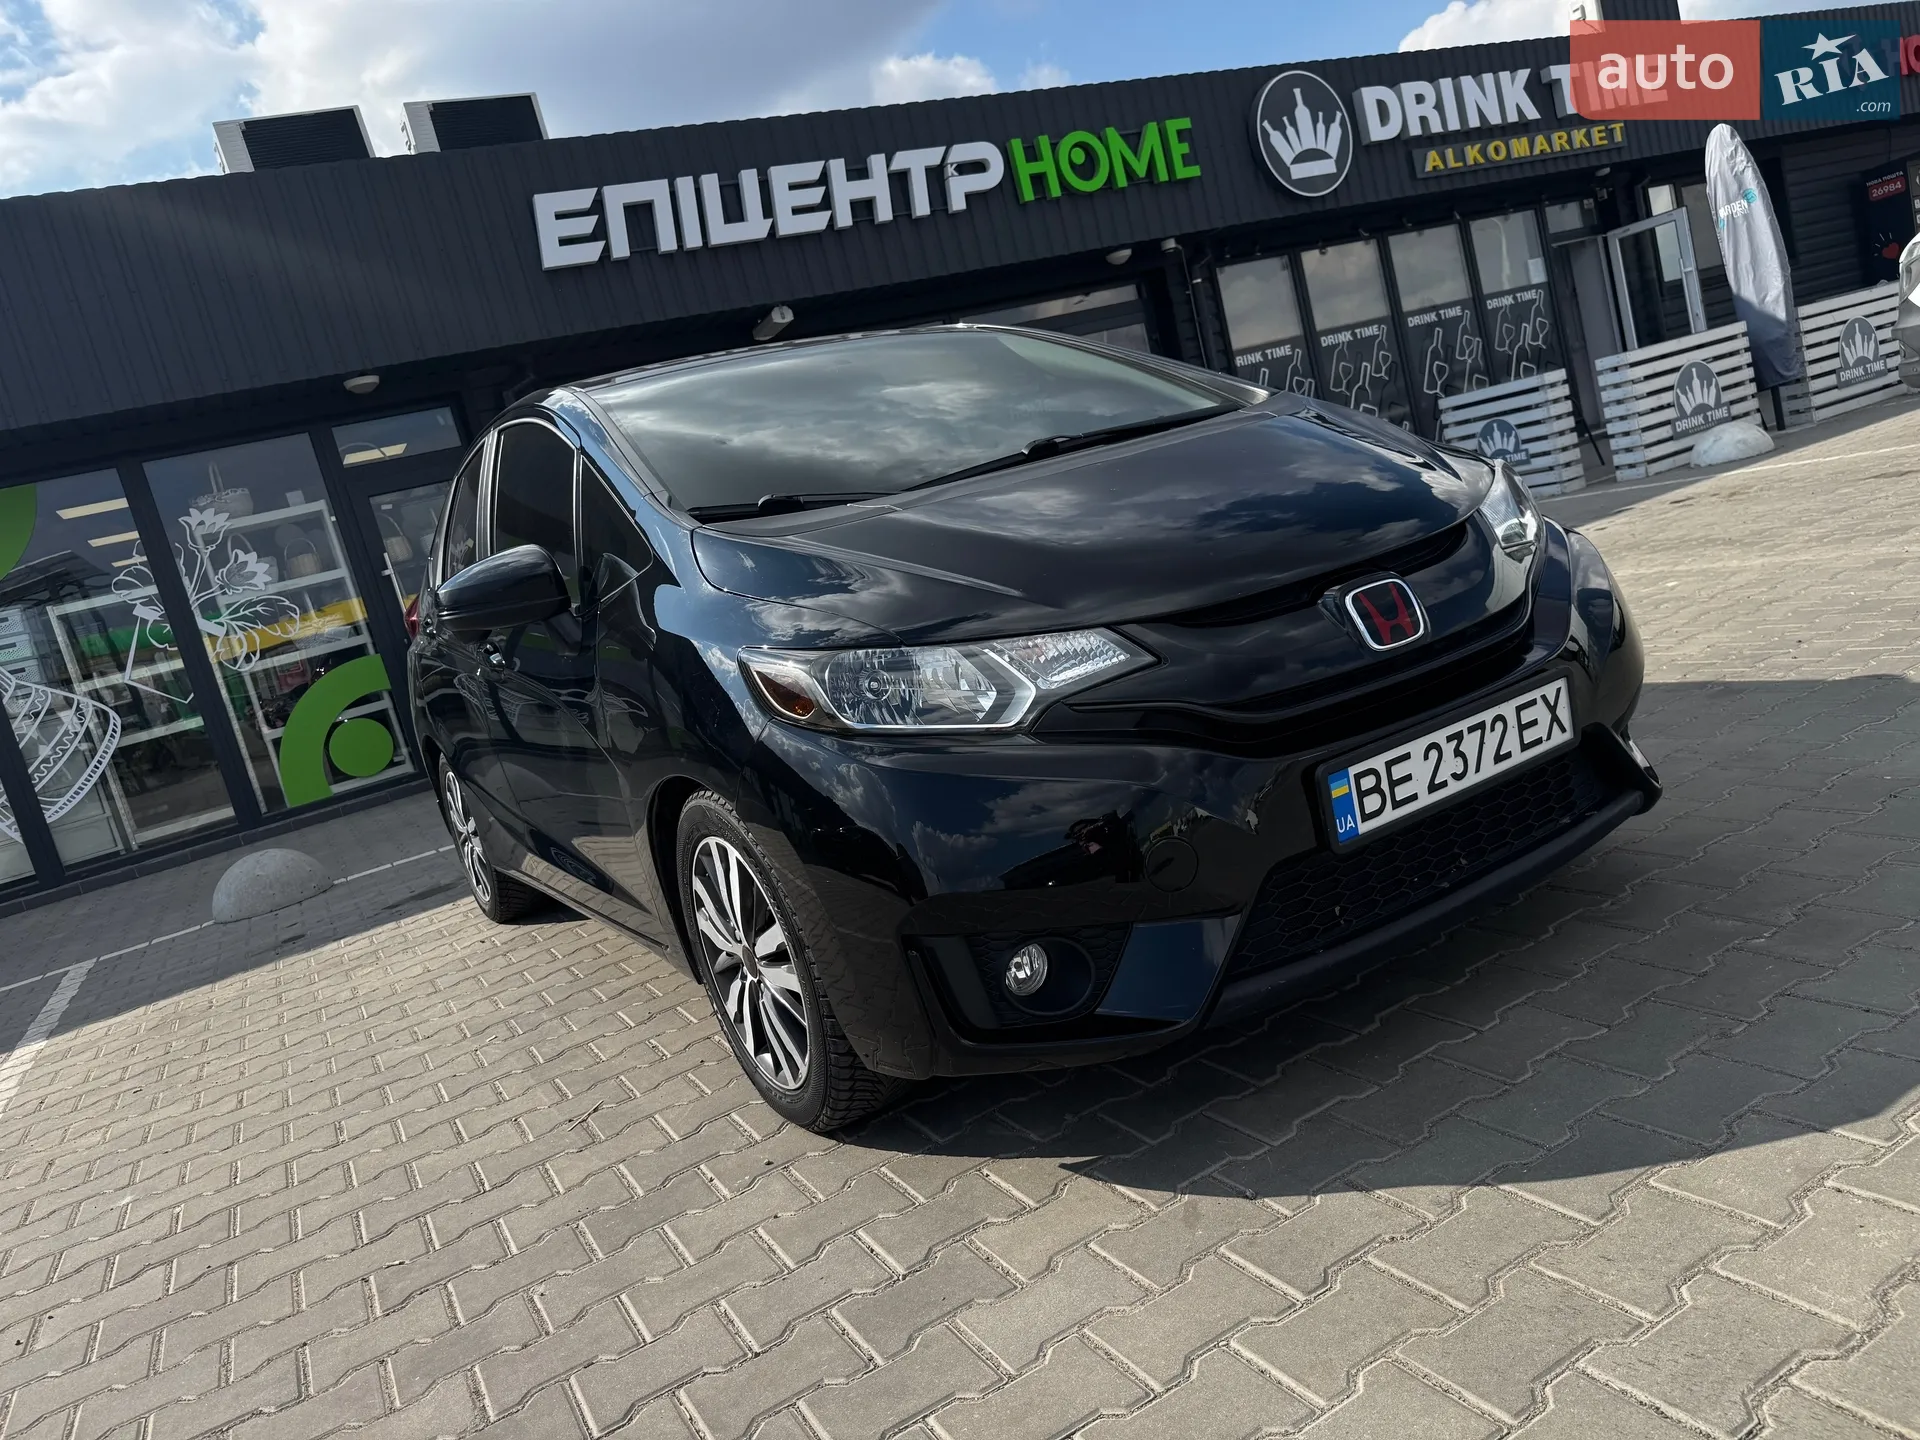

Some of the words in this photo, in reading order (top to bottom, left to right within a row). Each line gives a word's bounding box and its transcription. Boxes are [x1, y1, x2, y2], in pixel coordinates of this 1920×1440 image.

[1357, 68, 1541, 144] DRINK
[1544, 54, 1669, 118] TIME
[1424, 122, 1625, 173] ALKOMARKET
[1010, 117, 1202, 204] HOME
[1871, 181, 1902, 198] 26984
[533, 141, 1005, 271] ЕПІЦЕНТР
[1486, 294, 1515, 309] DRINK
[1515, 289, 1537, 303] TIME
[1407, 311, 1438, 327] DRINK
[1438, 305, 1463, 320] TIME
[1320, 330, 1353, 347] DRINK
[1354, 325, 1380, 339] TIME
[1235, 351, 1264, 367] RINK
[1264, 344, 1292, 360] TIME
[1840, 365, 1865, 382] DRINK
[1865, 360, 1886, 374] TIME
[1675, 413, 1705, 432] DRINK
[1705, 406, 1729, 422] TIME
[1505, 450, 1528, 462] TIME
[1353, 752, 1419, 823] BE
[1423, 713, 1513, 795] 2372
[1514, 686, 1567, 753] EX
[1336, 814, 1355, 833] UA
